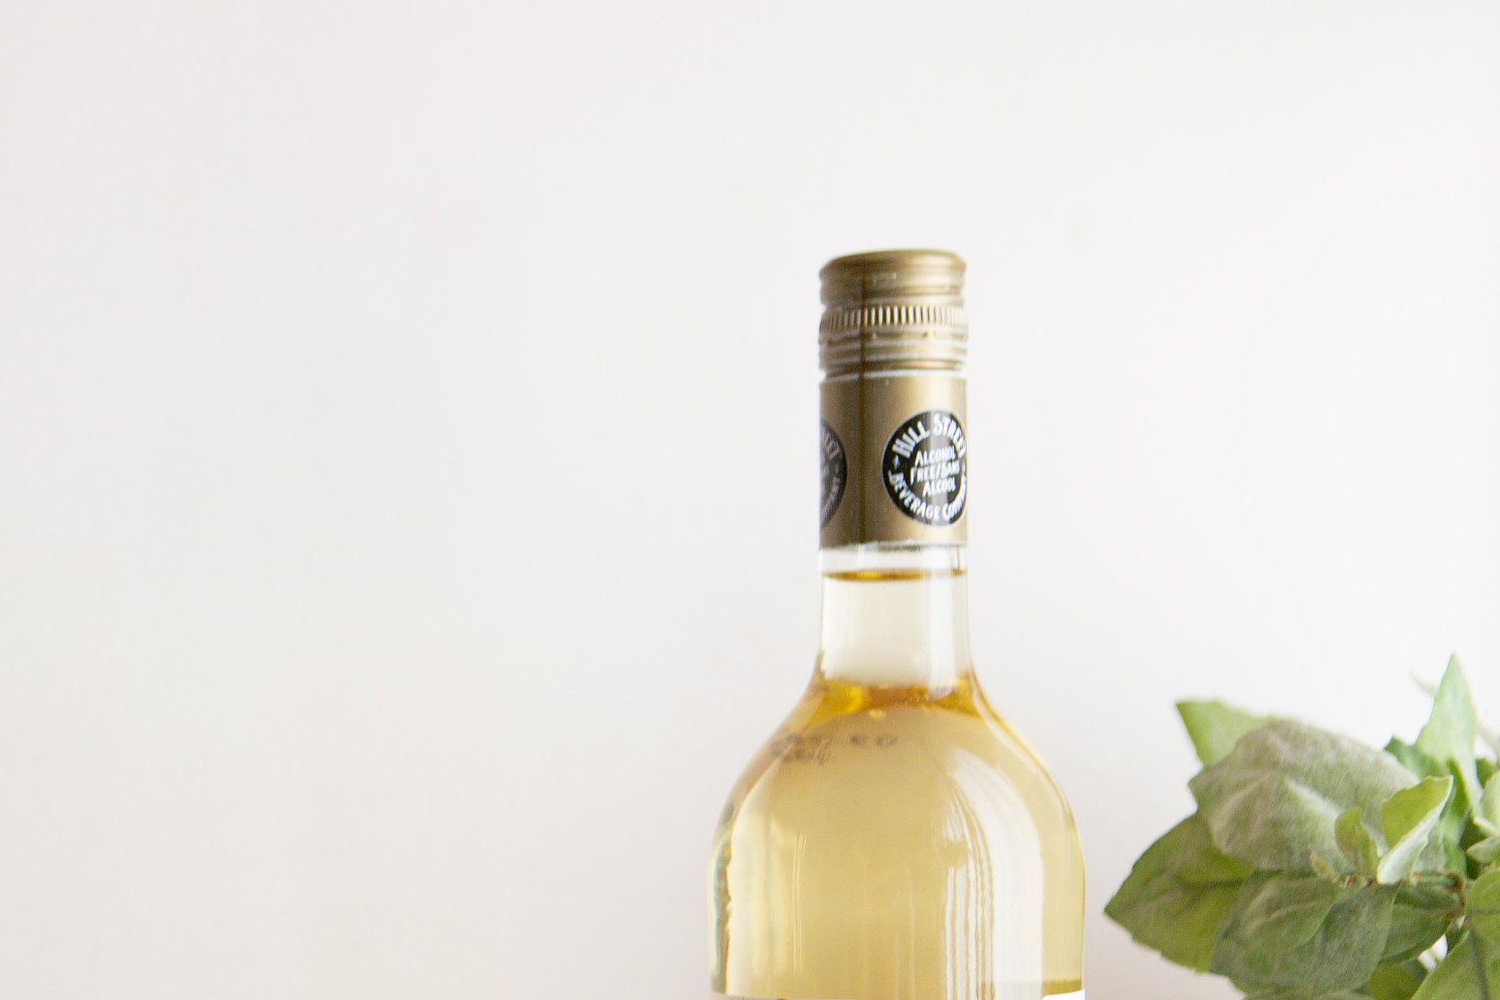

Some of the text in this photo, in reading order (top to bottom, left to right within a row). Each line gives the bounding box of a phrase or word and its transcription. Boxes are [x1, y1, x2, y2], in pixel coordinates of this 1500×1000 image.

[892, 420, 931, 459] HILL
[915, 446, 957, 468] ALCOHOL
[887, 469, 941, 520] BEVERAGE
[922, 476, 957, 497] ALCOOL
